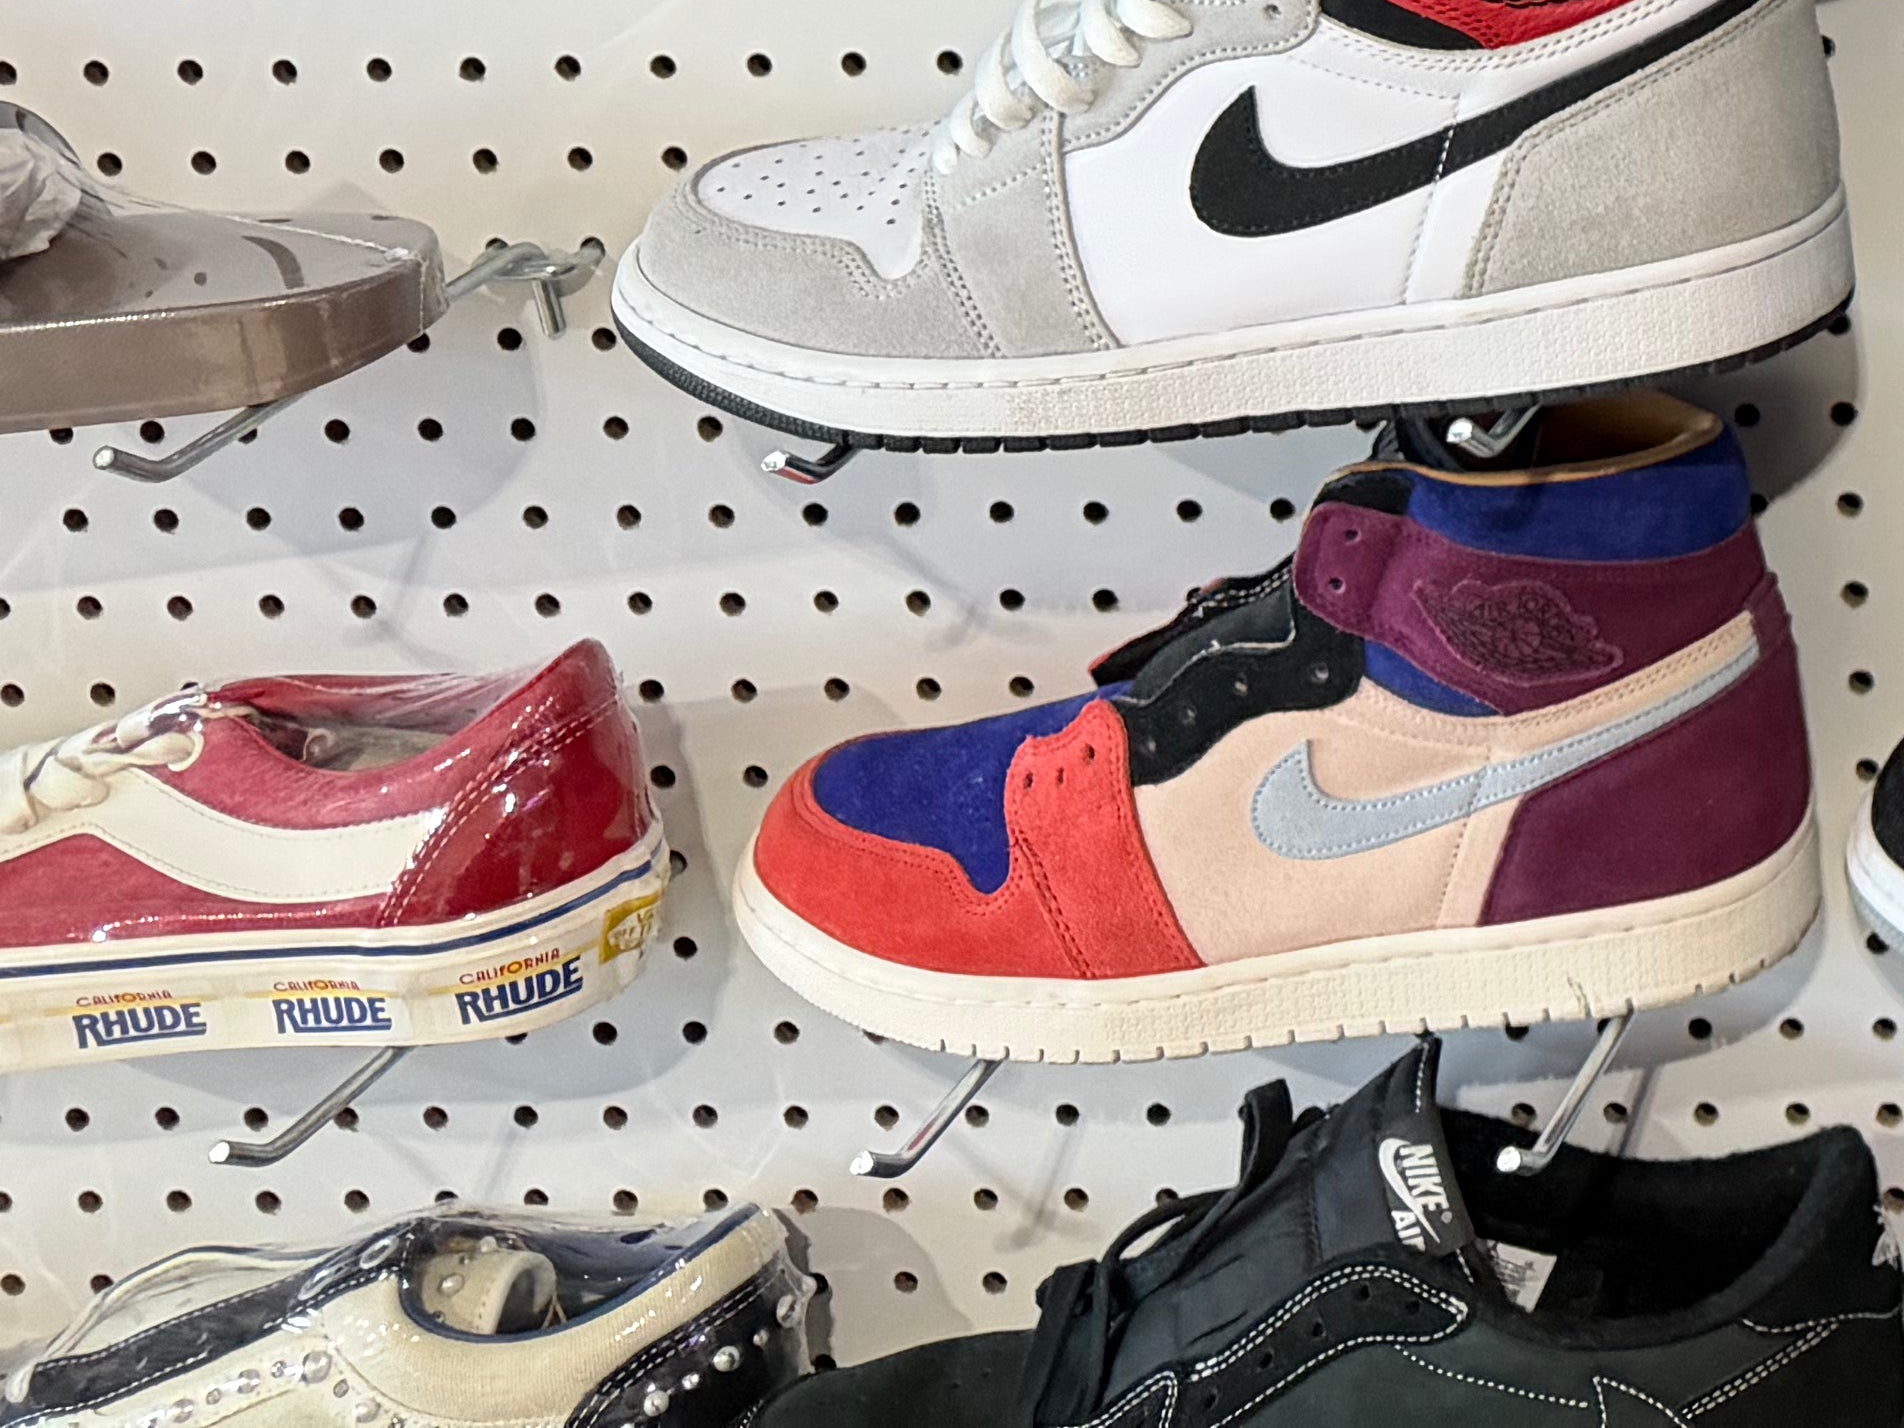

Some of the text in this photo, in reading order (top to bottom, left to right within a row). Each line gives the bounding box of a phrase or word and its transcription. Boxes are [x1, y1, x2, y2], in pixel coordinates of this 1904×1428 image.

[459, 947, 560, 985] CALIFORNIA
[76, 989, 173, 1008] CALIFORNIA
[273, 978, 360, 993] CALIFORNIA
[455, 955, 584, 1025] RHUDE
[72, 1002, 207, 1049] RHUDE
[272, 997, 393, 1034] RHUDE
[1399, 1144, 1450, 1212] NIKE
